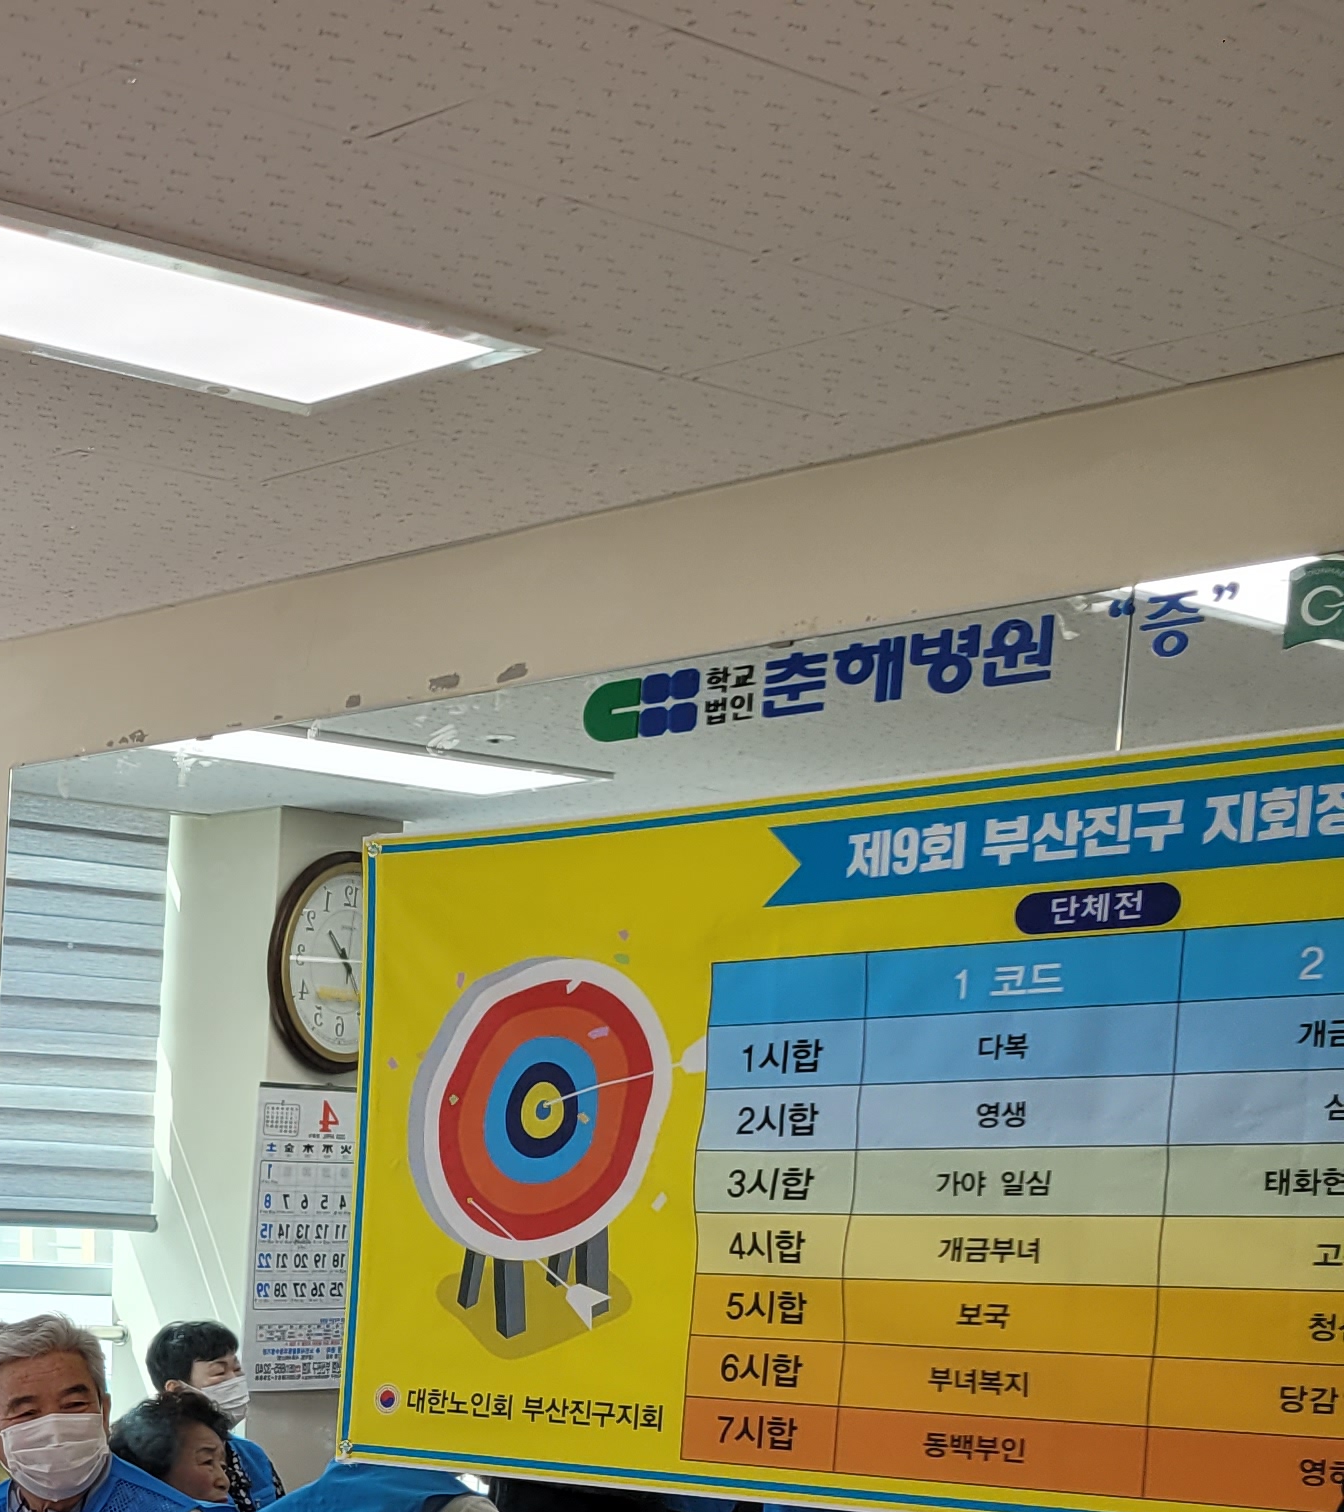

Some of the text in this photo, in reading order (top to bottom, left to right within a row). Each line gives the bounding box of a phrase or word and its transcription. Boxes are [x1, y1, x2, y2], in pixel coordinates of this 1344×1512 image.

[706, 663, 756, 693] 학교
[761, 614, 1055, 718] 춘해병원
[704, 694, 754, 726] 법인
[846, 821, 967, 879] 제9회
[981, 799, 1186, 867] 부산진구
[1050, 889, 1144, 925] 단체전
[1298, 945, 1325, 980] 2
[954, 962, 1065, 999] 1 코드
[742, 1038, 824, 1075] 1시합
[977, 1032, 1030, 1061] 다복
[735, 1102, 820, 1137] 2시합
[976, 1100, 1027, 1129] 영생
[726, 1167, 815, 1201] 3시합
[936, 1169, 1053, 1198] 가야 일심
[728, 1229, 806, 1265] 4시합
[937, 1236, 1041, 1265] 개금부녀
[725, 1289, 808, 1325] 5시합
[955, 1301, 1012, 1329] 보국
[1308, 1313, 1344, 1342] 청
[719, 1352, 804, 1389] 6시합
[927, 1365, 1030, 1398] 부녀복지
[406, 1387, 664, 1433] 대한노인회 부산진구지회
[1279, 1384, 1340, 1416] 당감
[716, 1414, 799, 1451] 7시합
[922, 1431, 1027, 1464] 동백부인
